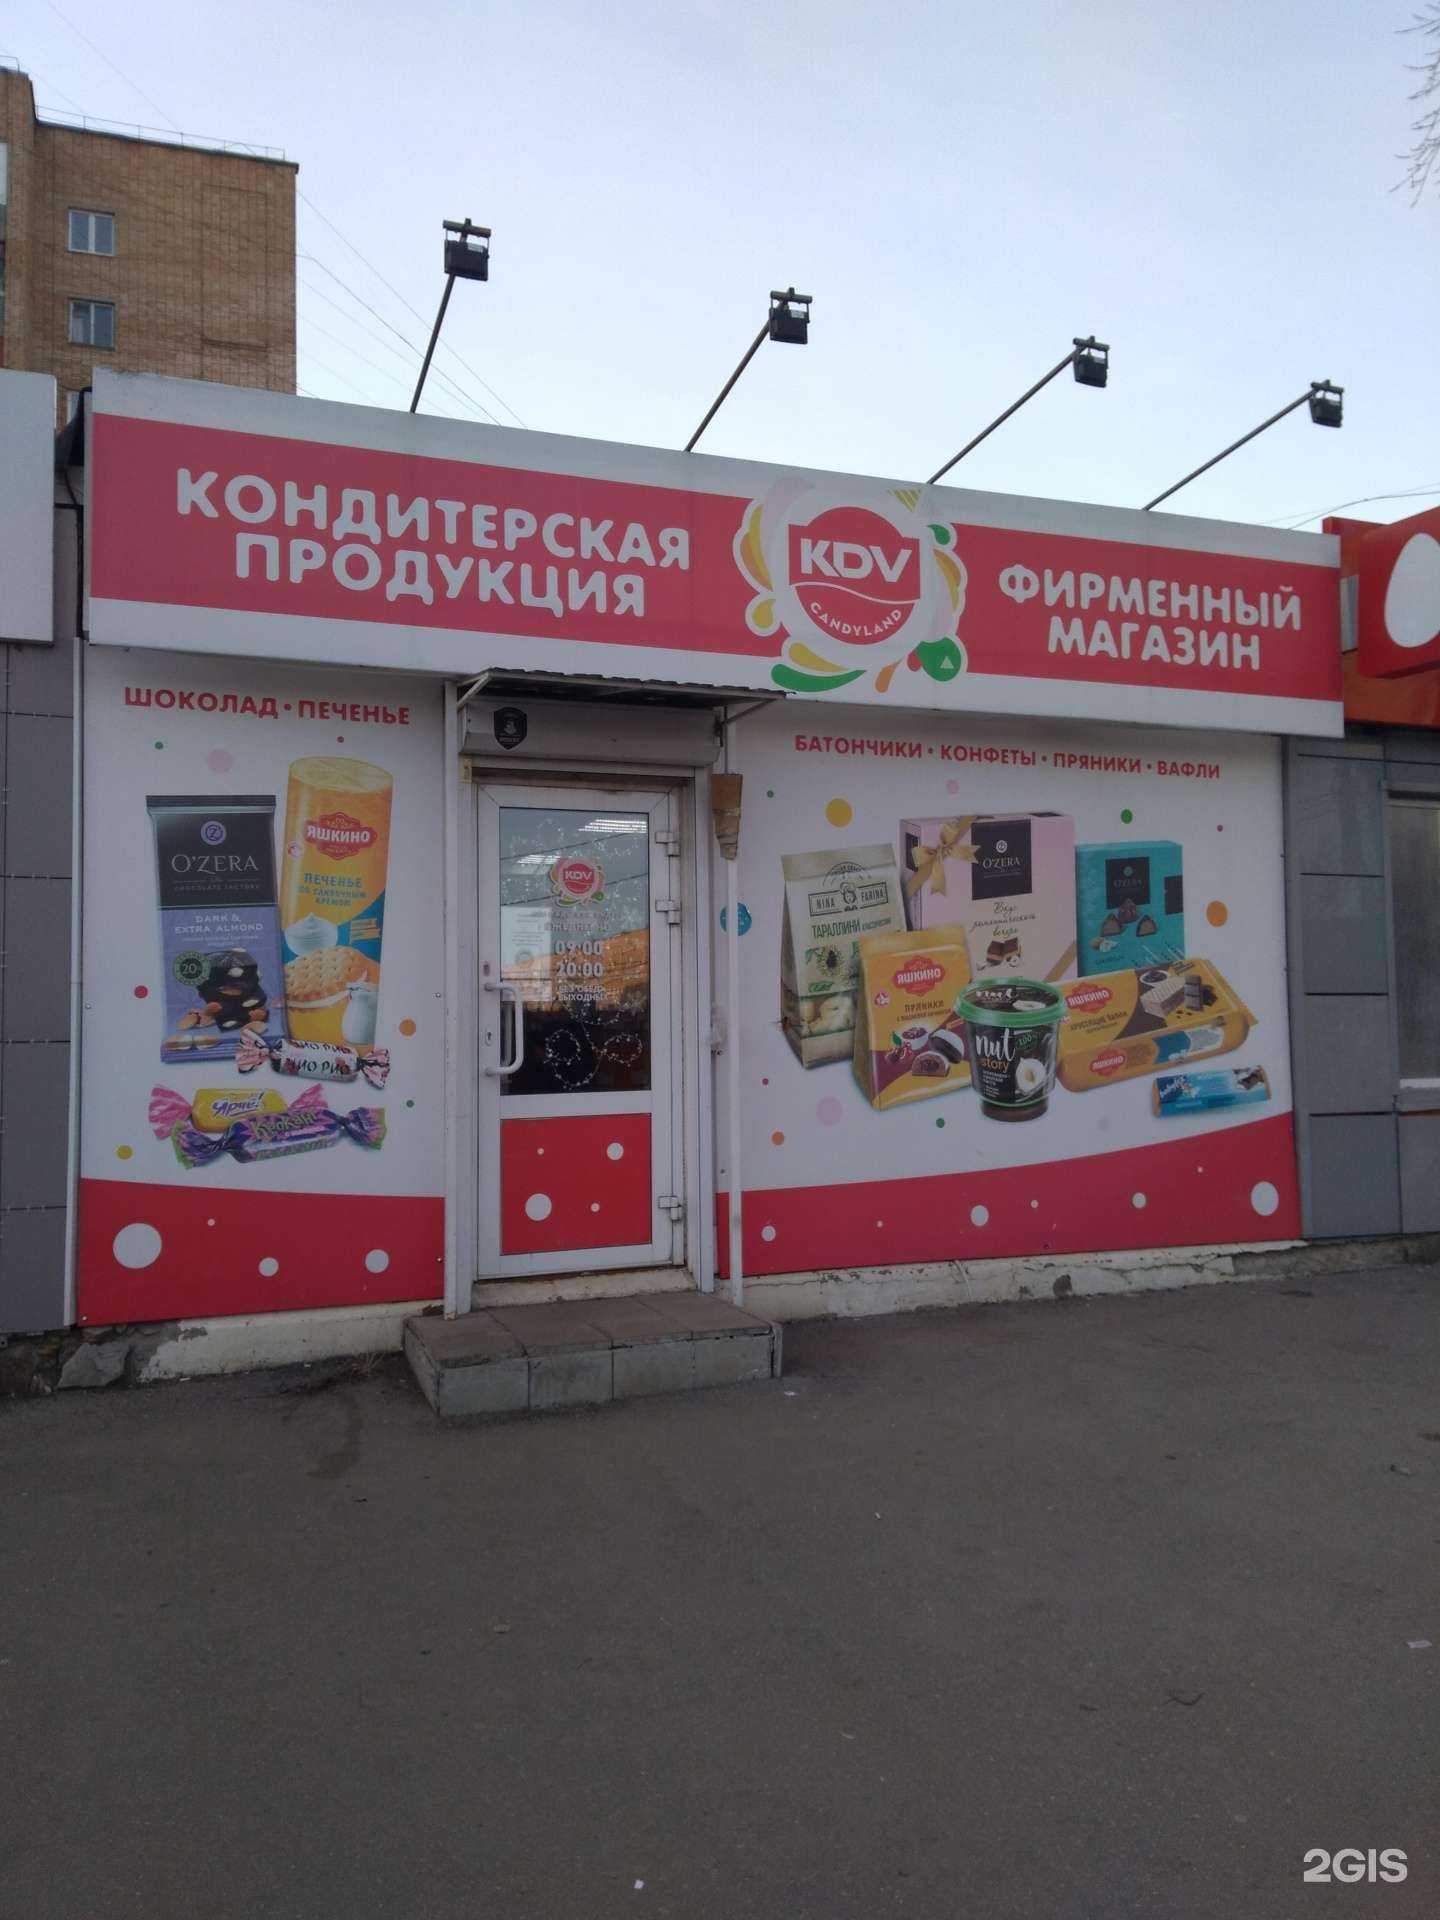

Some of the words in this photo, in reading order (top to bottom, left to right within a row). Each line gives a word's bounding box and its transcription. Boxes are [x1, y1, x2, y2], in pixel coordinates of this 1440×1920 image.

[176, 467, 691, 570] КОНДИТЕРСКАЯ
[800, 537, 912, 583] KDV
[235, 532, 646, 618] ПРОДУКЦИЯ
[999, 563, 1301, 631] ФИРМЕННЫЙ
[809, 600, 903, 638] CANDYLAND
[1048, 615, 1262, 671] МАГАЗИН
[124, 686, 280, 720] ШОКОЛАД
[298, 699, 411, 726] ПЕЧЕНЬЕ
[794, 734, 923, 759] БАТОНЧИКИ
[940, 745, 1037, 767] КОНФЕТЫ
[1053, 752, 1142, 776] ПРЯНИКИ
[1157, 760, 1221, 780] ВАФЛИ
[306, 825, 371, 844] ЯШКИНО
[171, 852, 259, 875] O'ZERA
[982, 856, 1021, 873] O'ZERA
[564, 870, 593, 880] KDV
[174, 924, 211, 934] EXTRA
[216, 922, 264, 932] ALMOND
[195, 915, 227, 925] DARK
[554, 939, 604, 956] 09:00
[555, 961, 604, 978] 20:00
[897, 967, 942, 985] ЯШКИНО
[1066, 989, 1110, 1006] ЯШКИНО
[975, 1028, 1016, 1062] nut
[981, 1057, 1010, 1074] story
